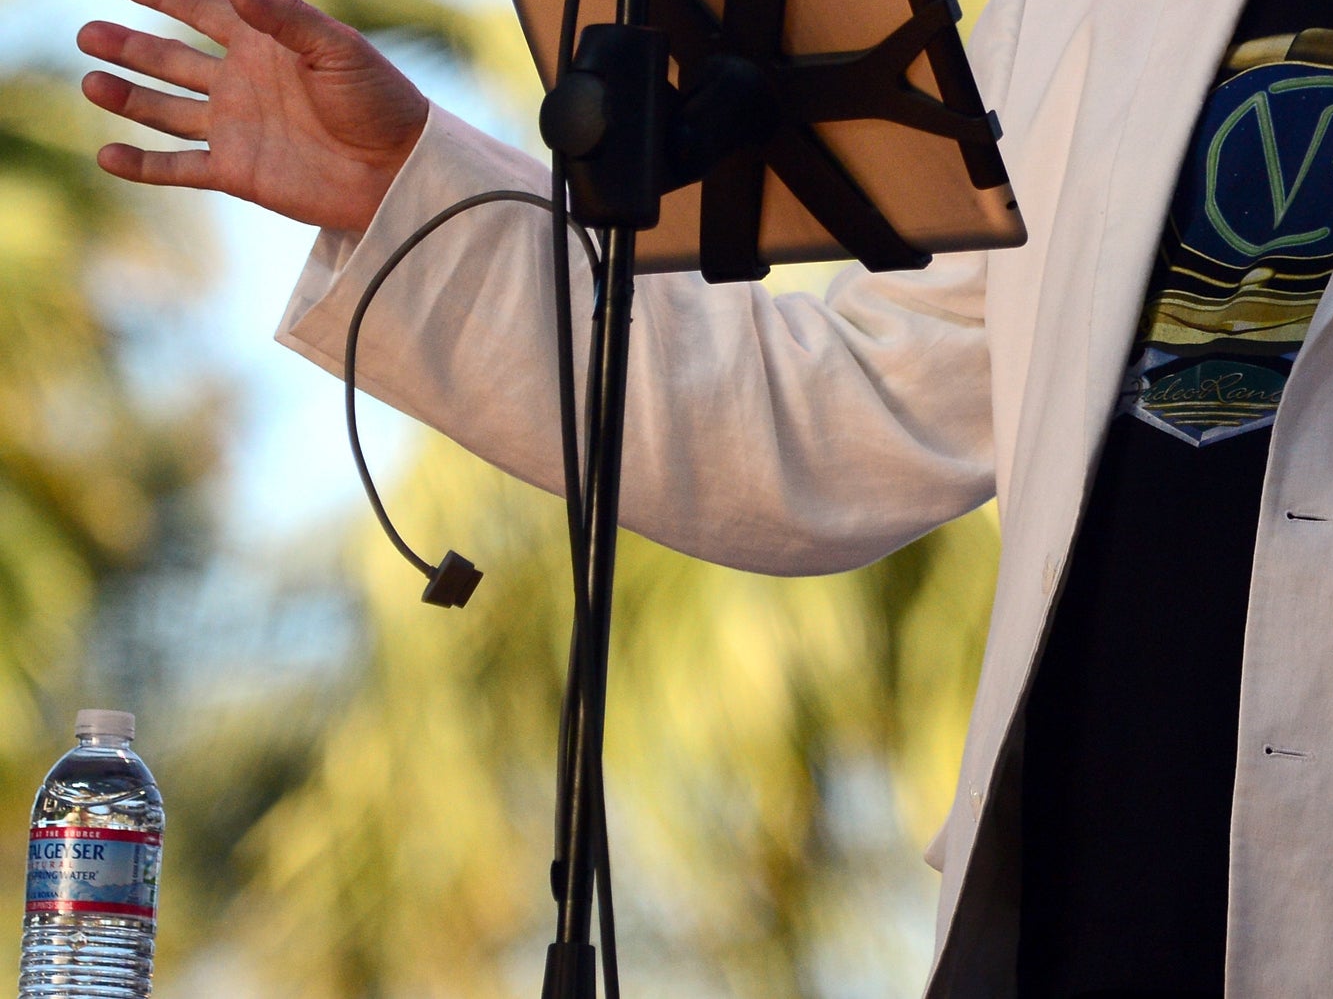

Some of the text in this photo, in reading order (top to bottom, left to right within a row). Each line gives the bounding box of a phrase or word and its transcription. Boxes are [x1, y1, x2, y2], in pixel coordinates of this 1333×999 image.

[45, 830, 59, 838] THE
[63, 829, 101, 838] SOURCE
[44, 843, 105, 860] GEYSER
